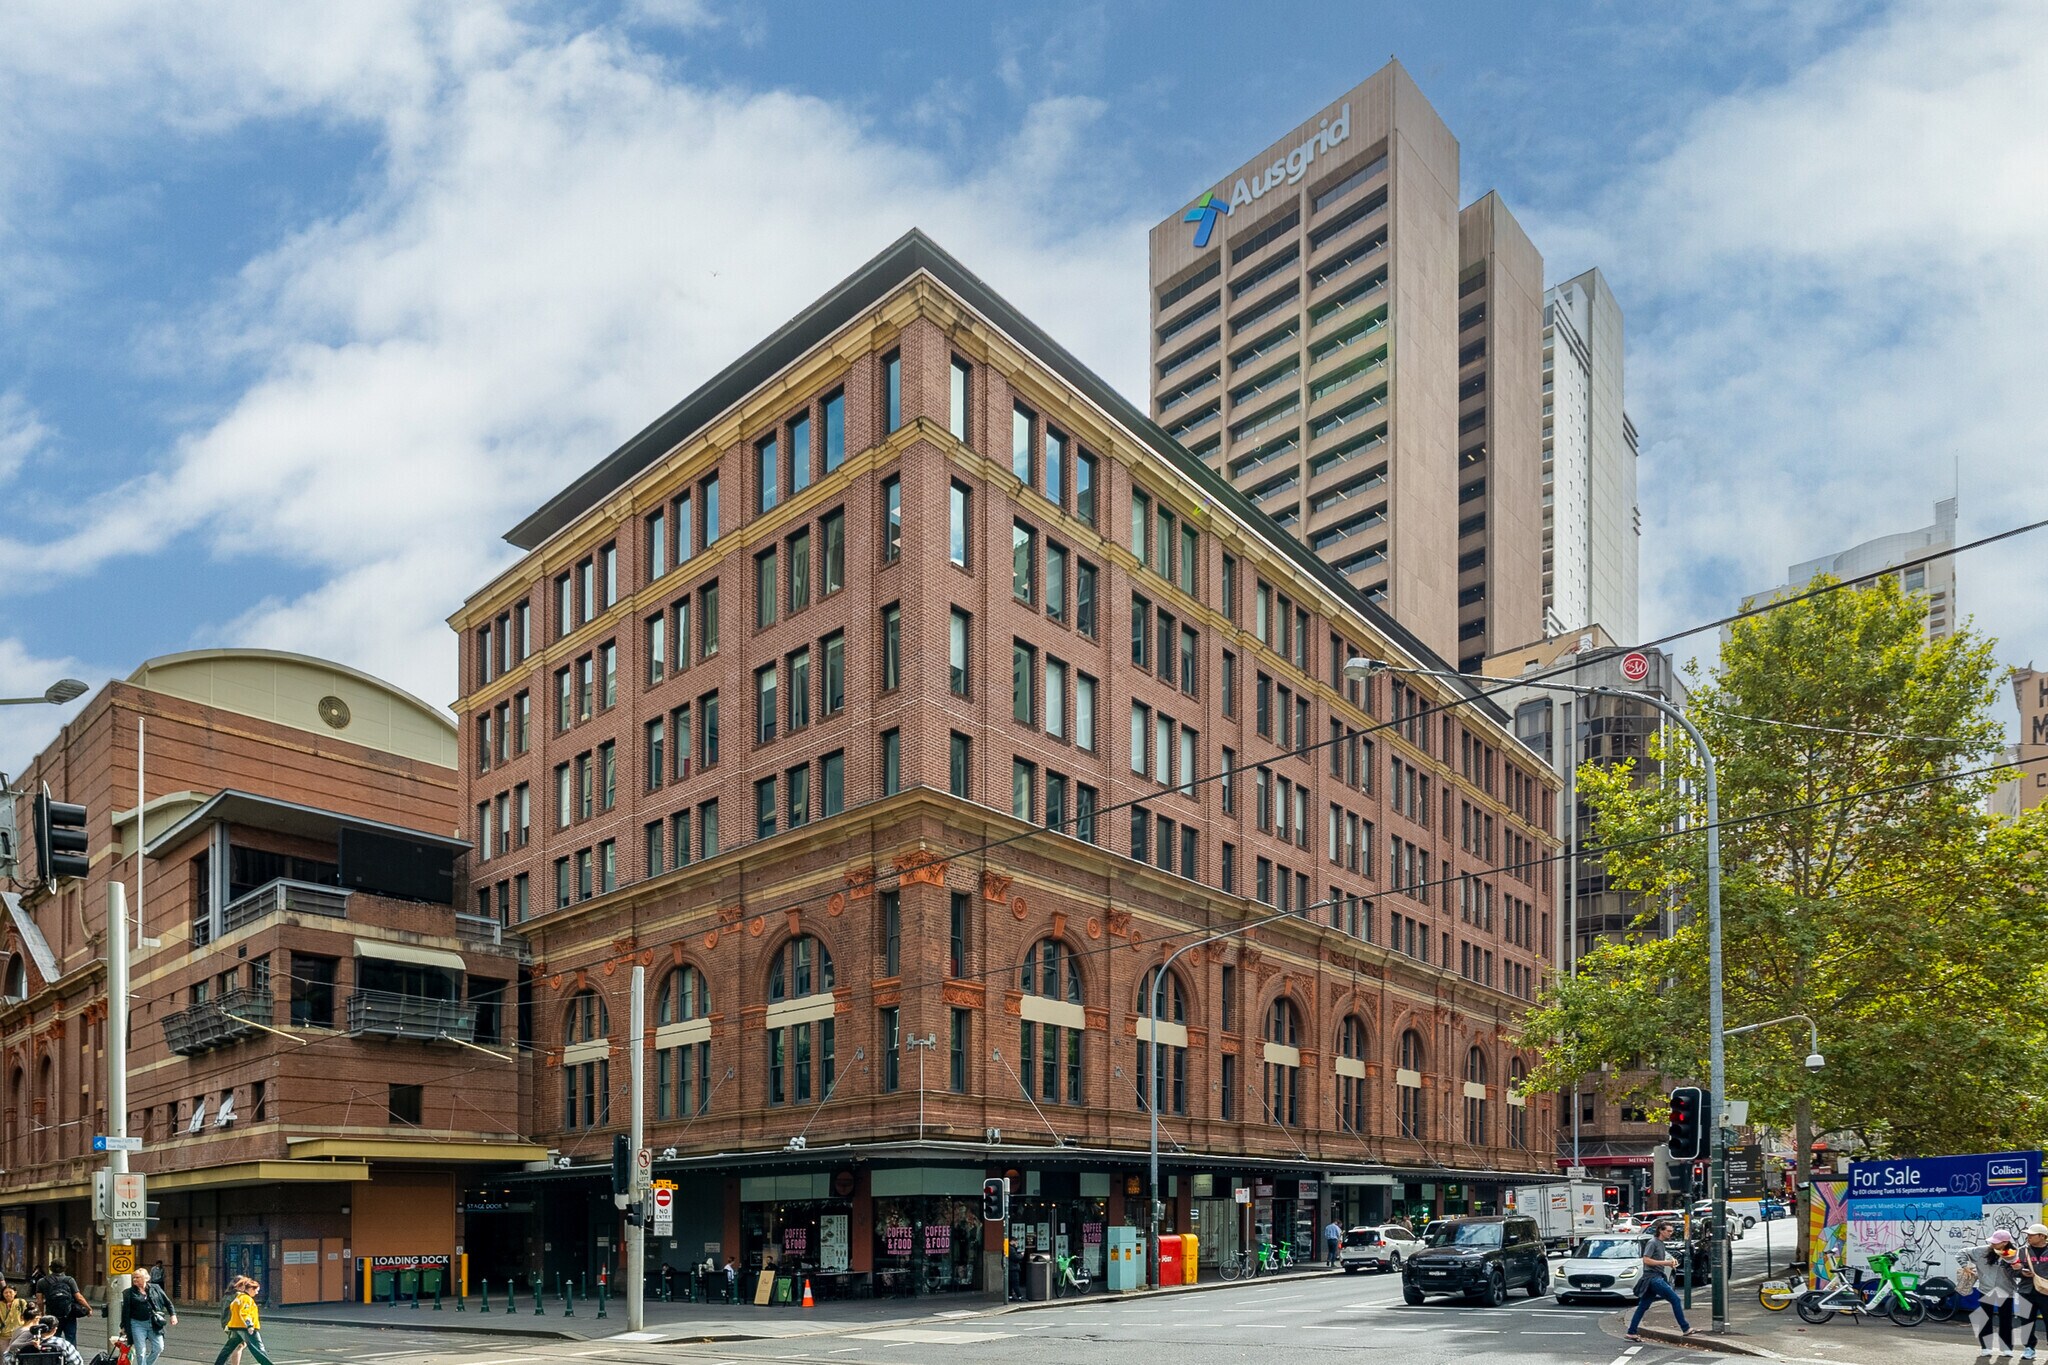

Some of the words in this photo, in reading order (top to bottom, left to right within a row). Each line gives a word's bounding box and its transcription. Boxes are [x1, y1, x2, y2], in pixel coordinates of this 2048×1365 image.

[1228, 103, 1351, 217] Ausgrid
[1853, 1169, 1880, 1187] For
[1884, 1165, 1921, 1186] Sale
[1991, 1165, 2023, 1176] Colliers
[122, 1201, 137, 1209] NO
[784, 1228, 807, 1239] COFFEE
[887, 1226, 913, 1238] COFFEE
[925, 1225, 951, 1237] COFFEE
[1082, 1223, 1102, 1233] COFFEE
[887, 1238, 893, 1249] &
[893, 1238, 912, 1249] FOOD
[925, 1238, 931, 1249] &
[931, 1237, 950, 1248] FOOD
[1088, 1233, 1102, 1243] FOOD
[785, 1239, 790, 1249] &
[790, 1239, 807, 1249] FOOD
[116, 1260, 129, 1269] 20
[375, 1256, 419, 1265] LOADING
[421, 1255, 448, 1264] DOCK
